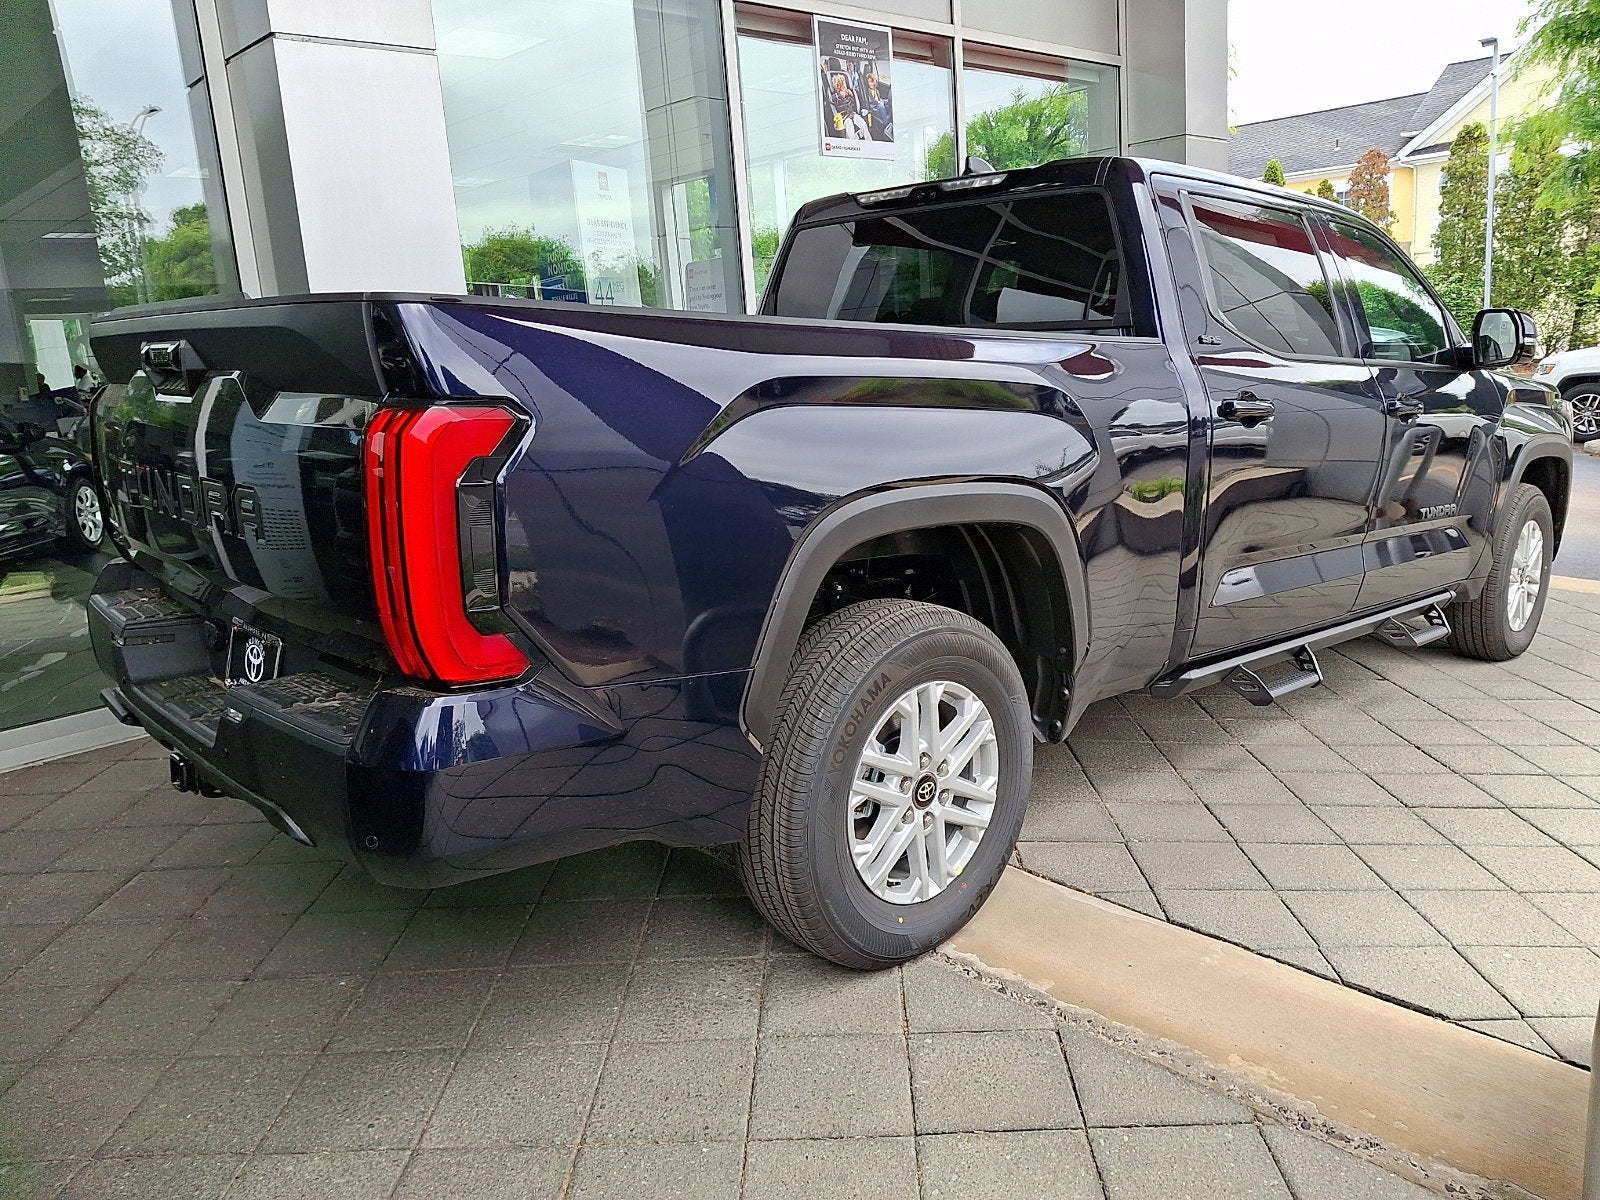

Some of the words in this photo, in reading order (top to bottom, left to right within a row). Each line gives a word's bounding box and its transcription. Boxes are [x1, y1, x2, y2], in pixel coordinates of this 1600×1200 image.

[840, 33, 855, 43] DEAR
[586, 218, 600, 228] DEAR
[595, 280, 615, 306] 44
[1419, 503, 1458, 520] TUNDRA
[828, 672, 892, 775] YOKOHAMA
